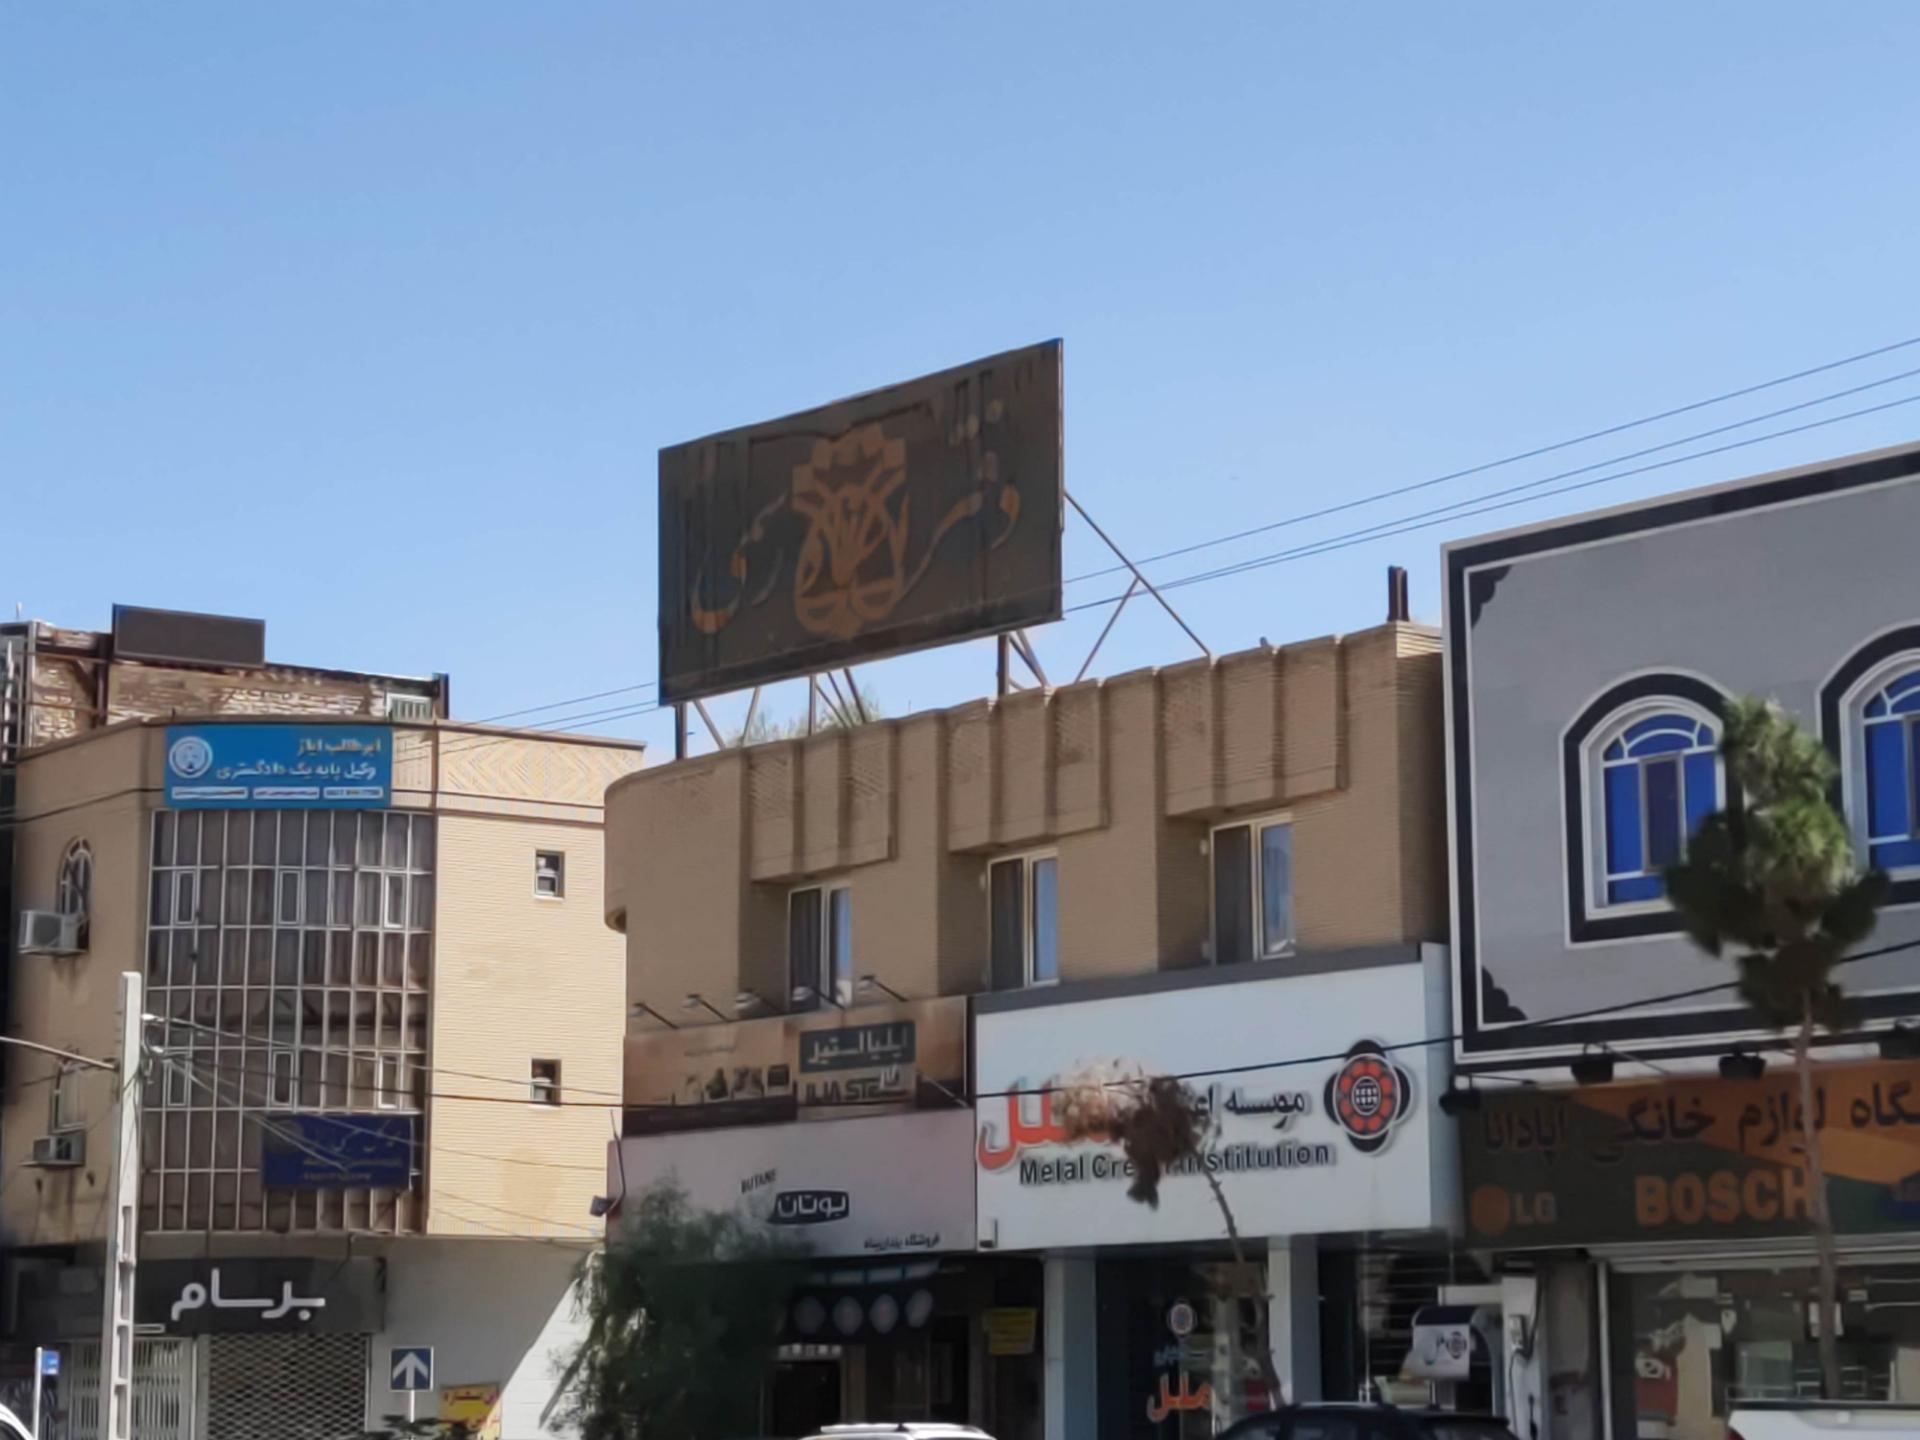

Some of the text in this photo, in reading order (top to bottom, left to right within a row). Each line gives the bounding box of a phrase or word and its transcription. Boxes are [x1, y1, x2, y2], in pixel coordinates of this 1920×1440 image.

[216, 759, 287, 780] دادگستری
[315, 761, 341, 782] پایه
[344, 760, 377, 780] وکیل
[1592, 1096, 1716, 1163] خانگی
[1019, 1155, 1084, 1185] Melal
[776, 1193, 848, 1219] بوتان
[1514, 1167, 1817, 1227] LG BOSCH
